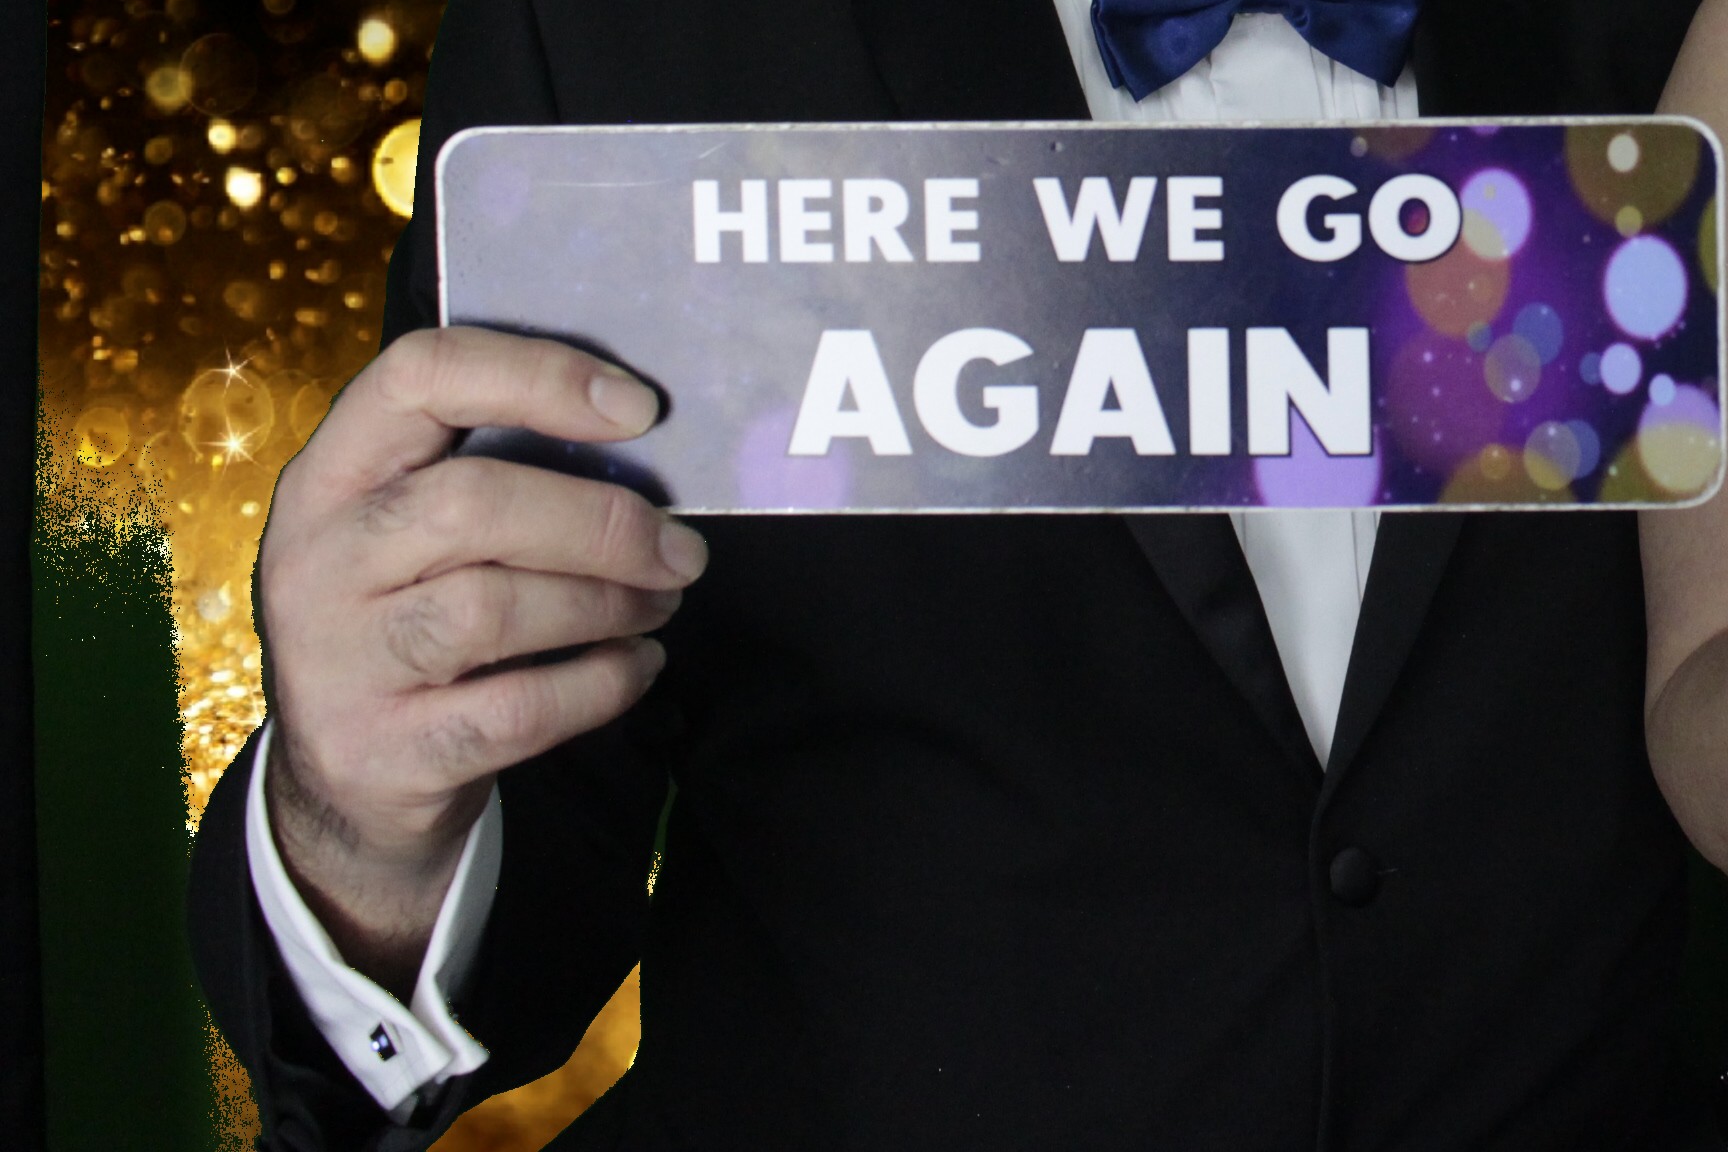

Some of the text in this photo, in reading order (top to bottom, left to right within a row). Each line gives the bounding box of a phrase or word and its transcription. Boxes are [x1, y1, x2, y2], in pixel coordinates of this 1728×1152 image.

[691, 172, 1464, 264] HERE WE GO
[787, 325, 1374, 459] AGAIN
